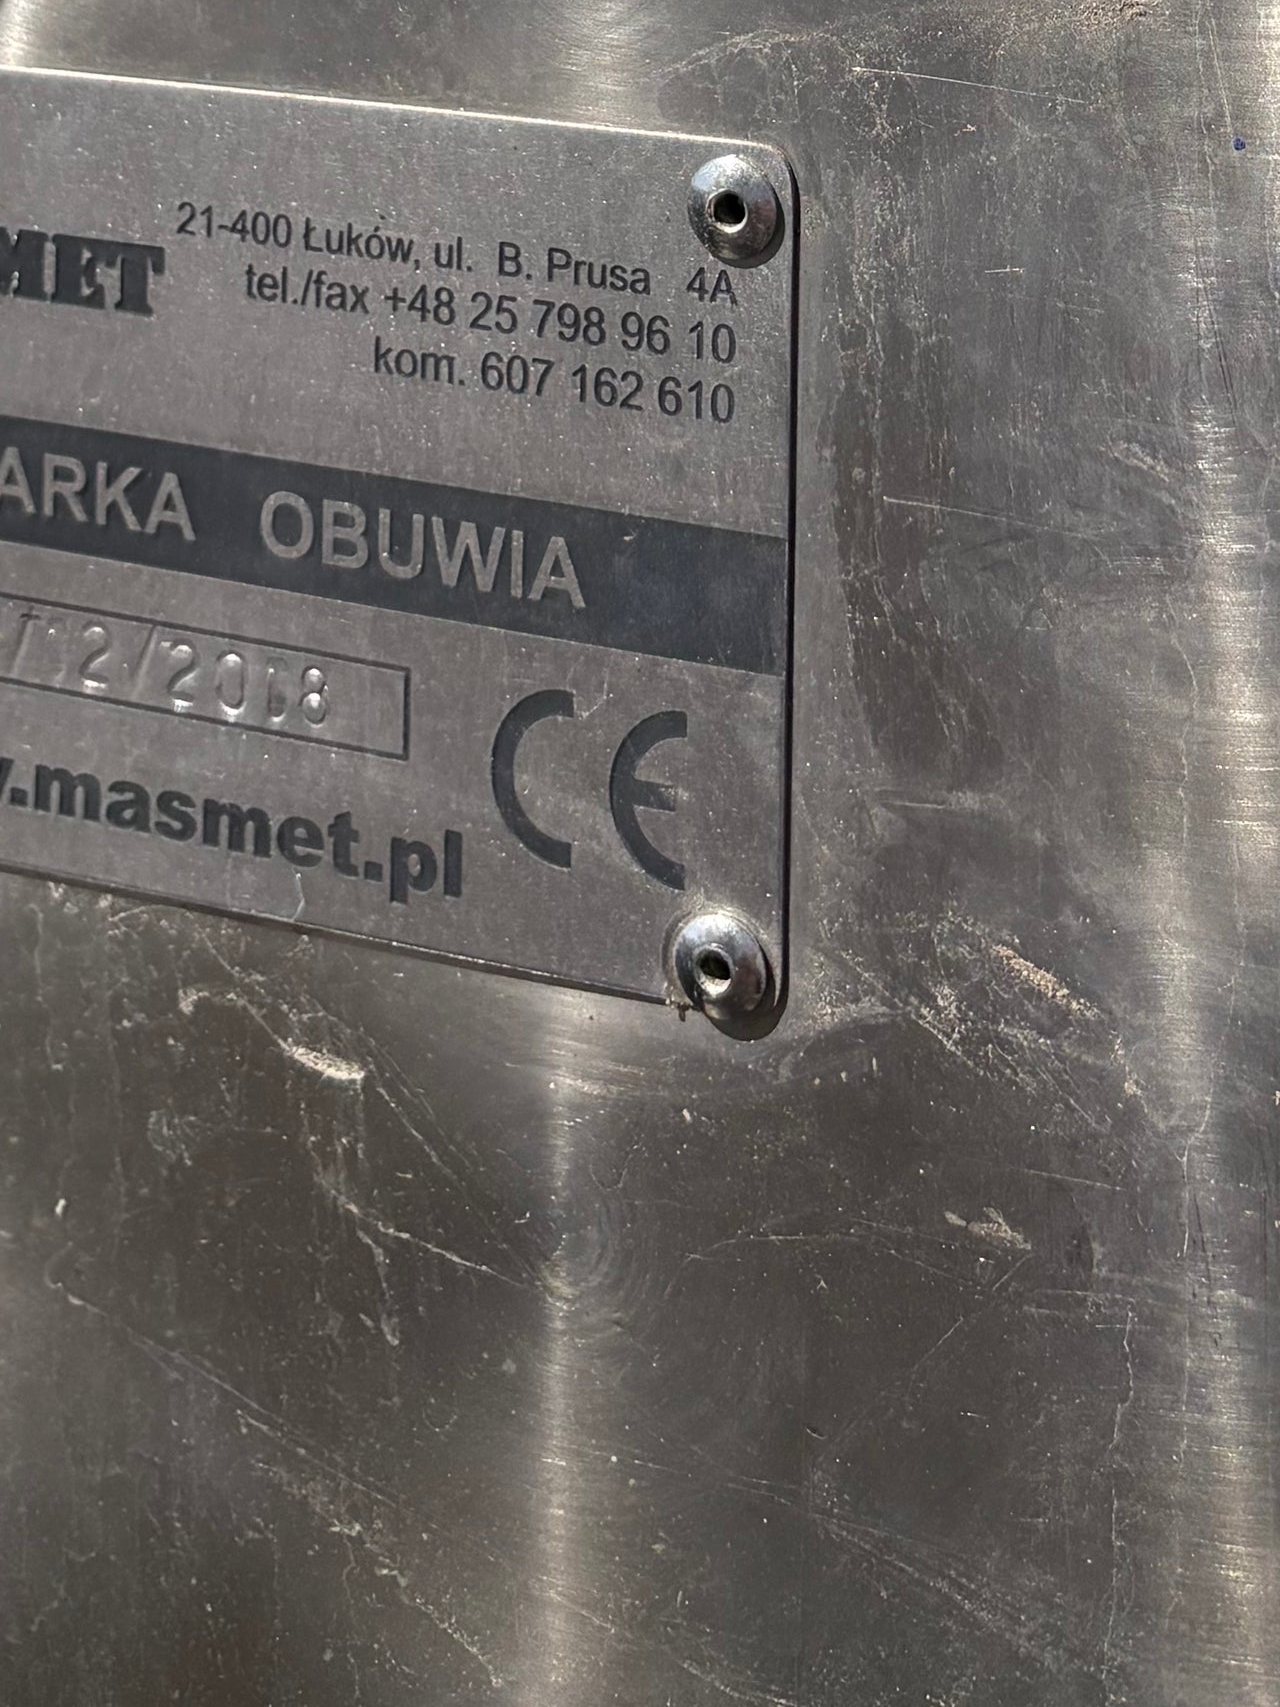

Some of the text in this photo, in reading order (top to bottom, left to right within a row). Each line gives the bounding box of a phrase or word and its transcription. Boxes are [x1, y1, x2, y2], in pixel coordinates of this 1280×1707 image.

[176, 201, 738, 306] 21-400 Łuków, ul. B. Prusa 4A
[245, 263, 737, 365] tel./fax +48 25 798 96 10
[373, 336, 736, 424] kom. 607 162 610
[260, 490, 587, 610] OBUWIA
